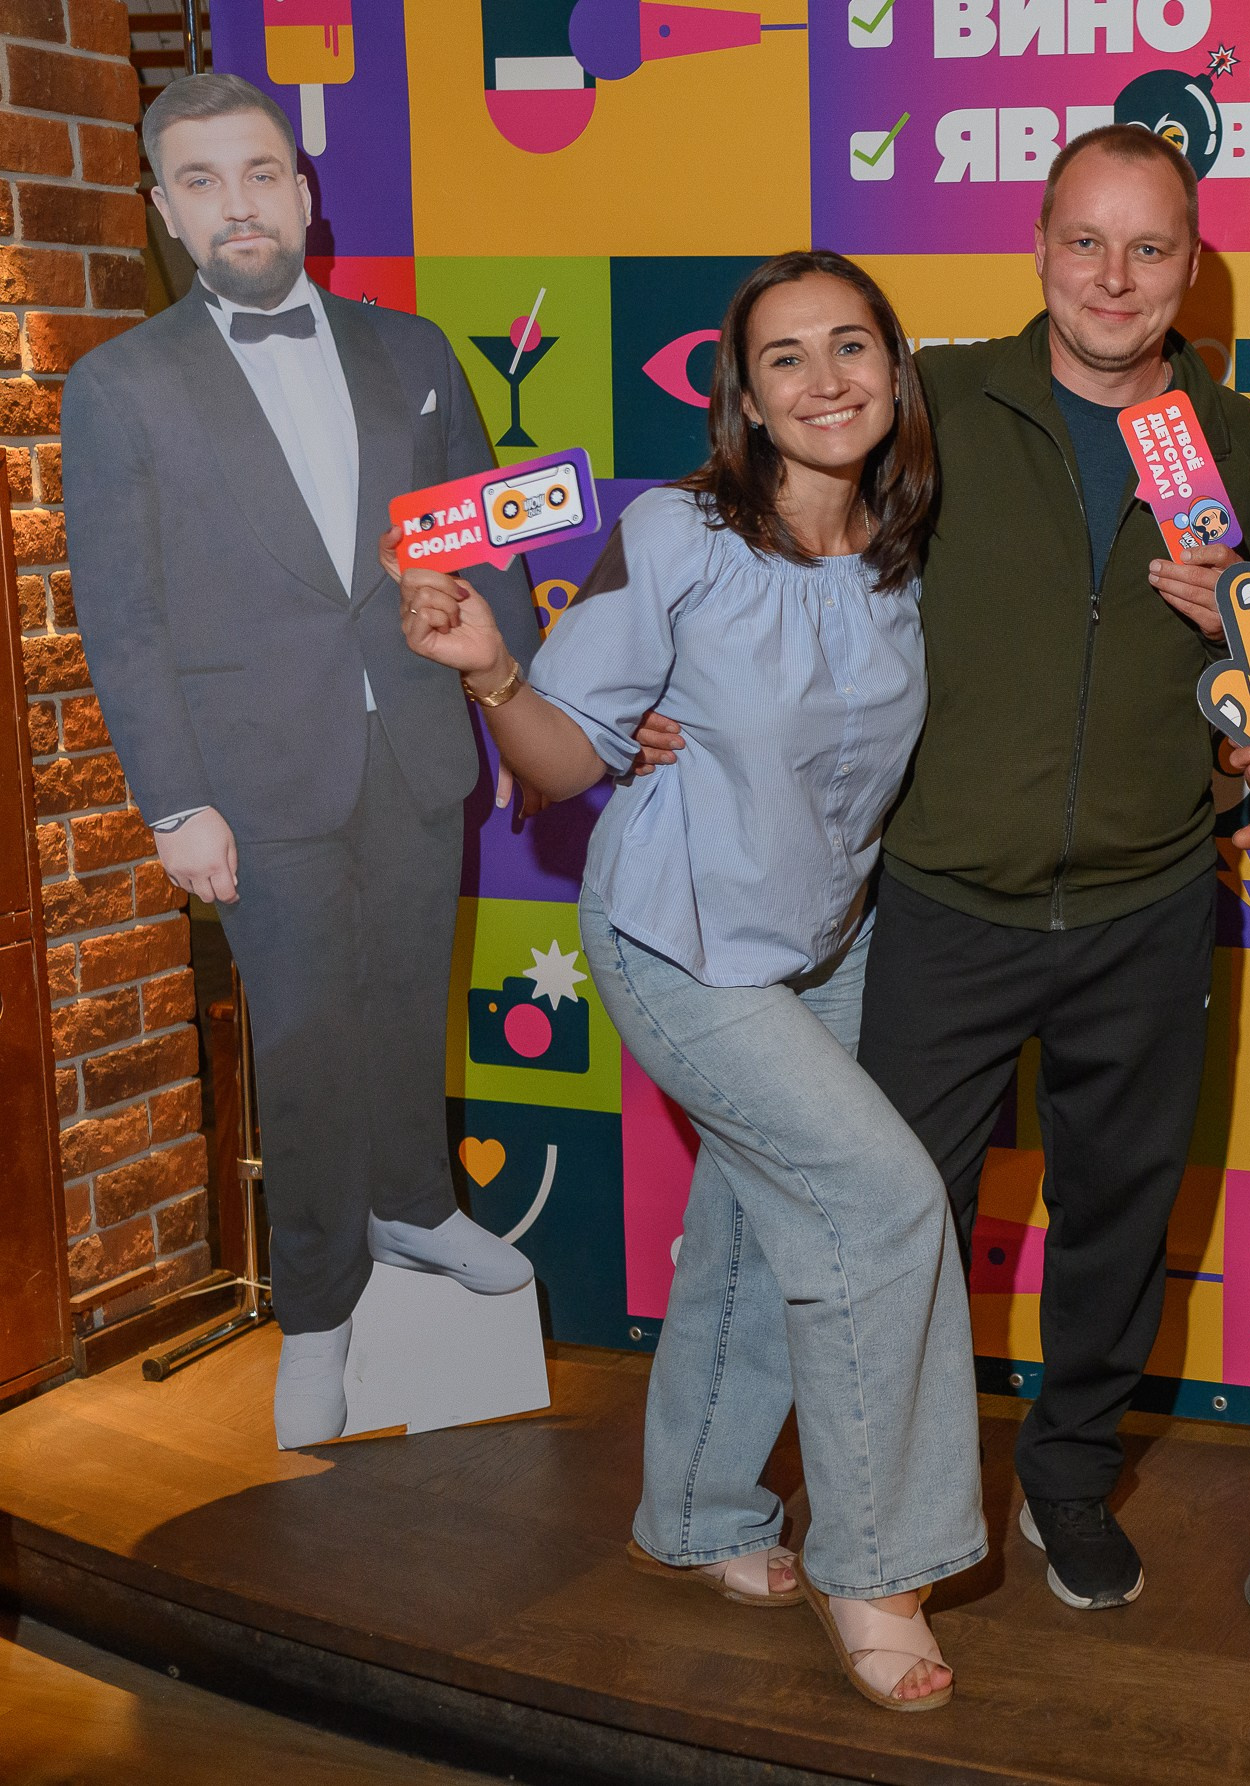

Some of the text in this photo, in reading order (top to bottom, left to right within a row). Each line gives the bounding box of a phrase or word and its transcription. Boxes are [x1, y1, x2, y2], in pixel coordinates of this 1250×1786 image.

[933, 0, 1213, 59] ВИНО
[1131, 417, 1175, 500] ШАТАЛ!
[1147, 412, 1193, 499] ДЕТСТВО
[1165, 405, 1205, 472] Я ТВОЁ
[408, 526, 483, 560] СЮДА!
